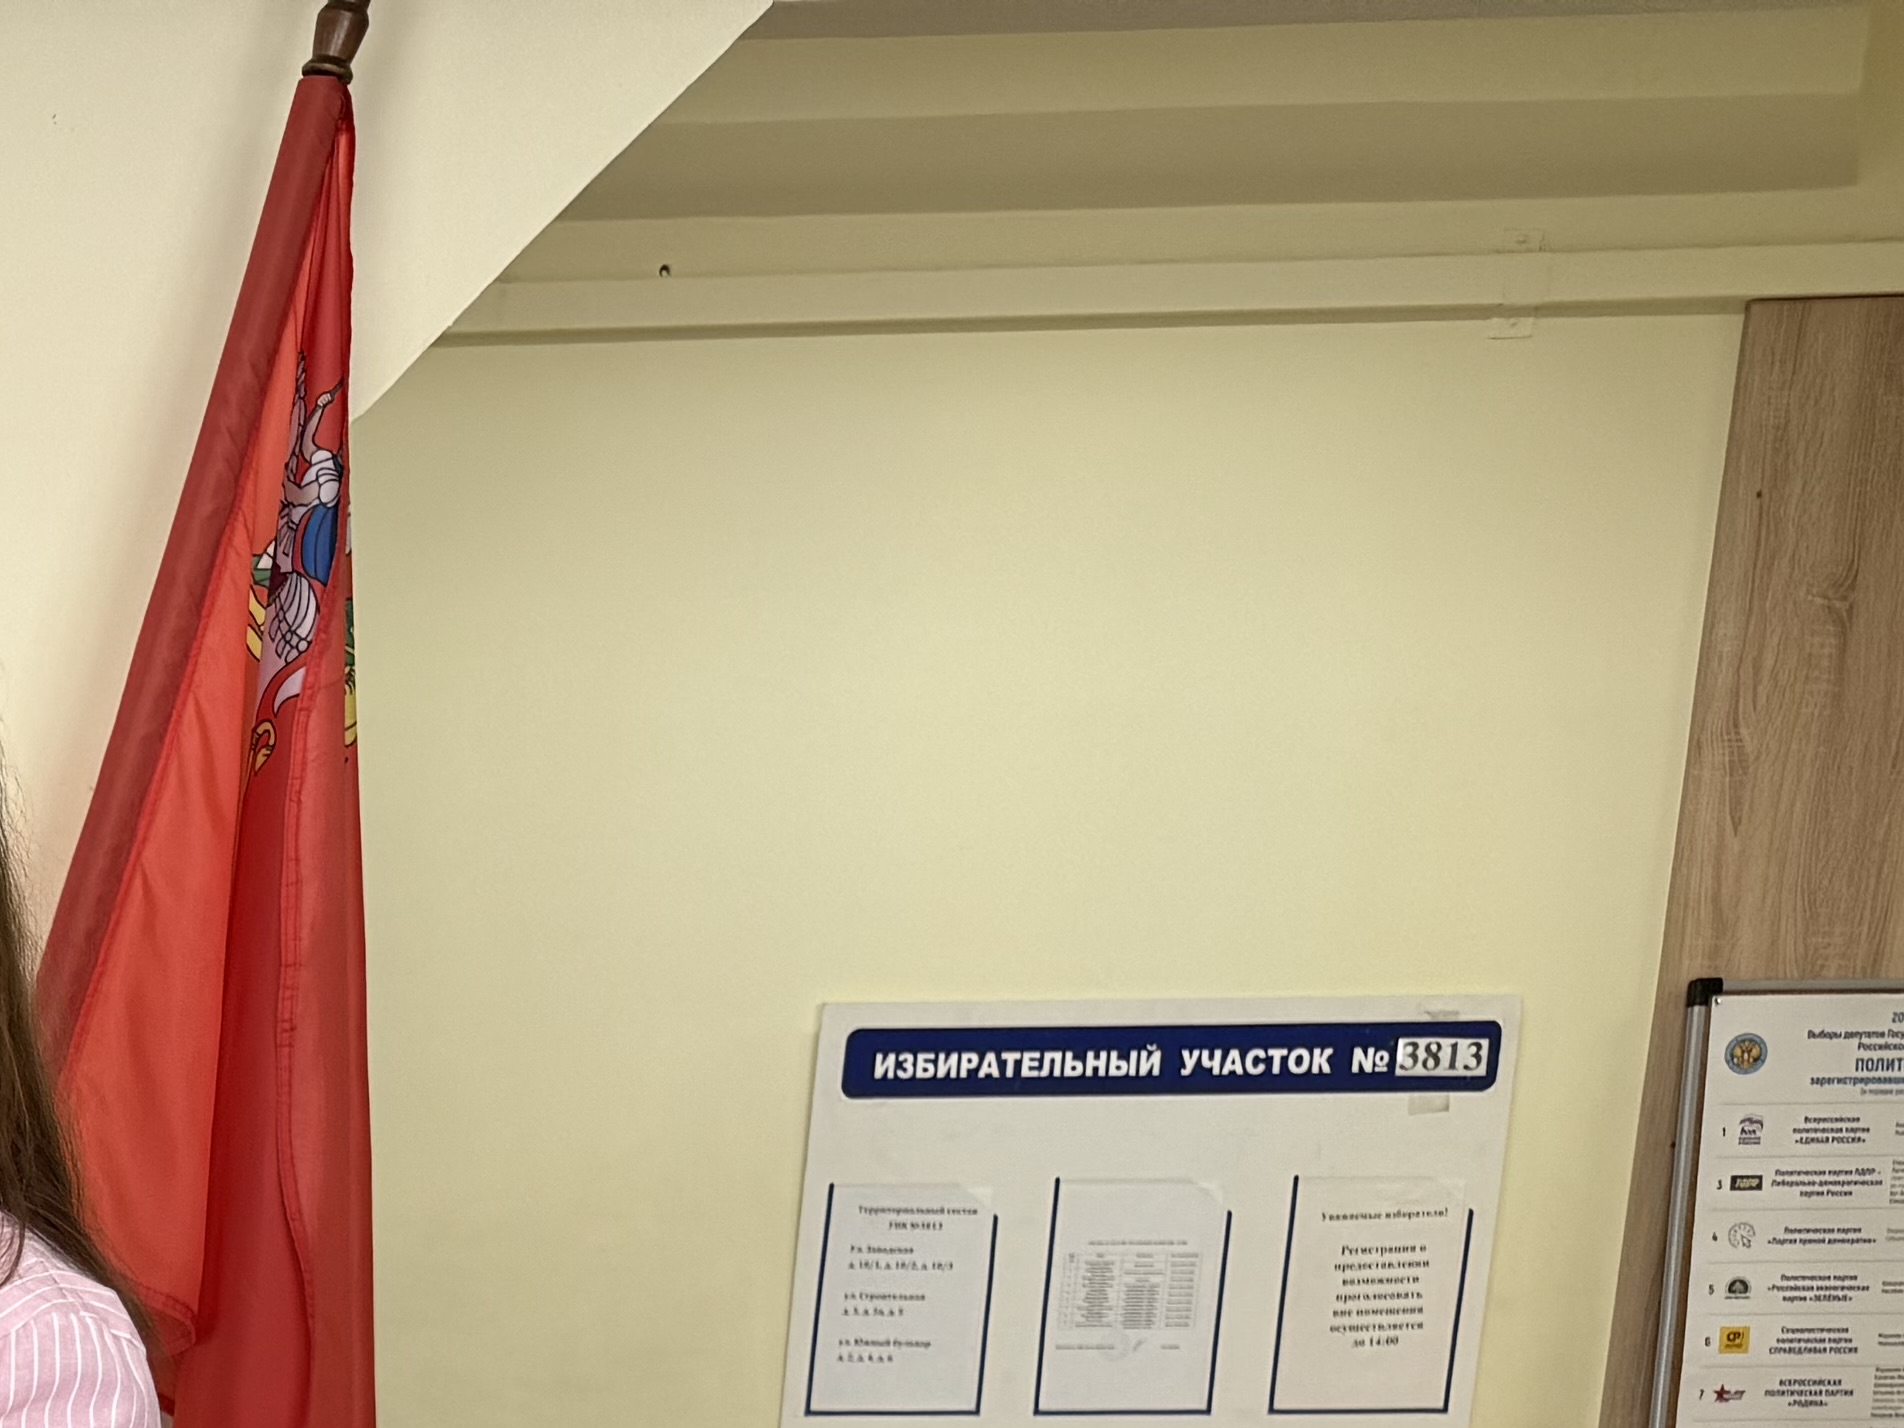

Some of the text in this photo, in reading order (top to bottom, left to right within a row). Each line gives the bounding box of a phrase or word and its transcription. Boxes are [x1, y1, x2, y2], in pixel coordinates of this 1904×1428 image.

[874, 1041, 1485, 1080] ИЗБИРАТЕЛЬНЫЙ УЧАСТОК № 3813
